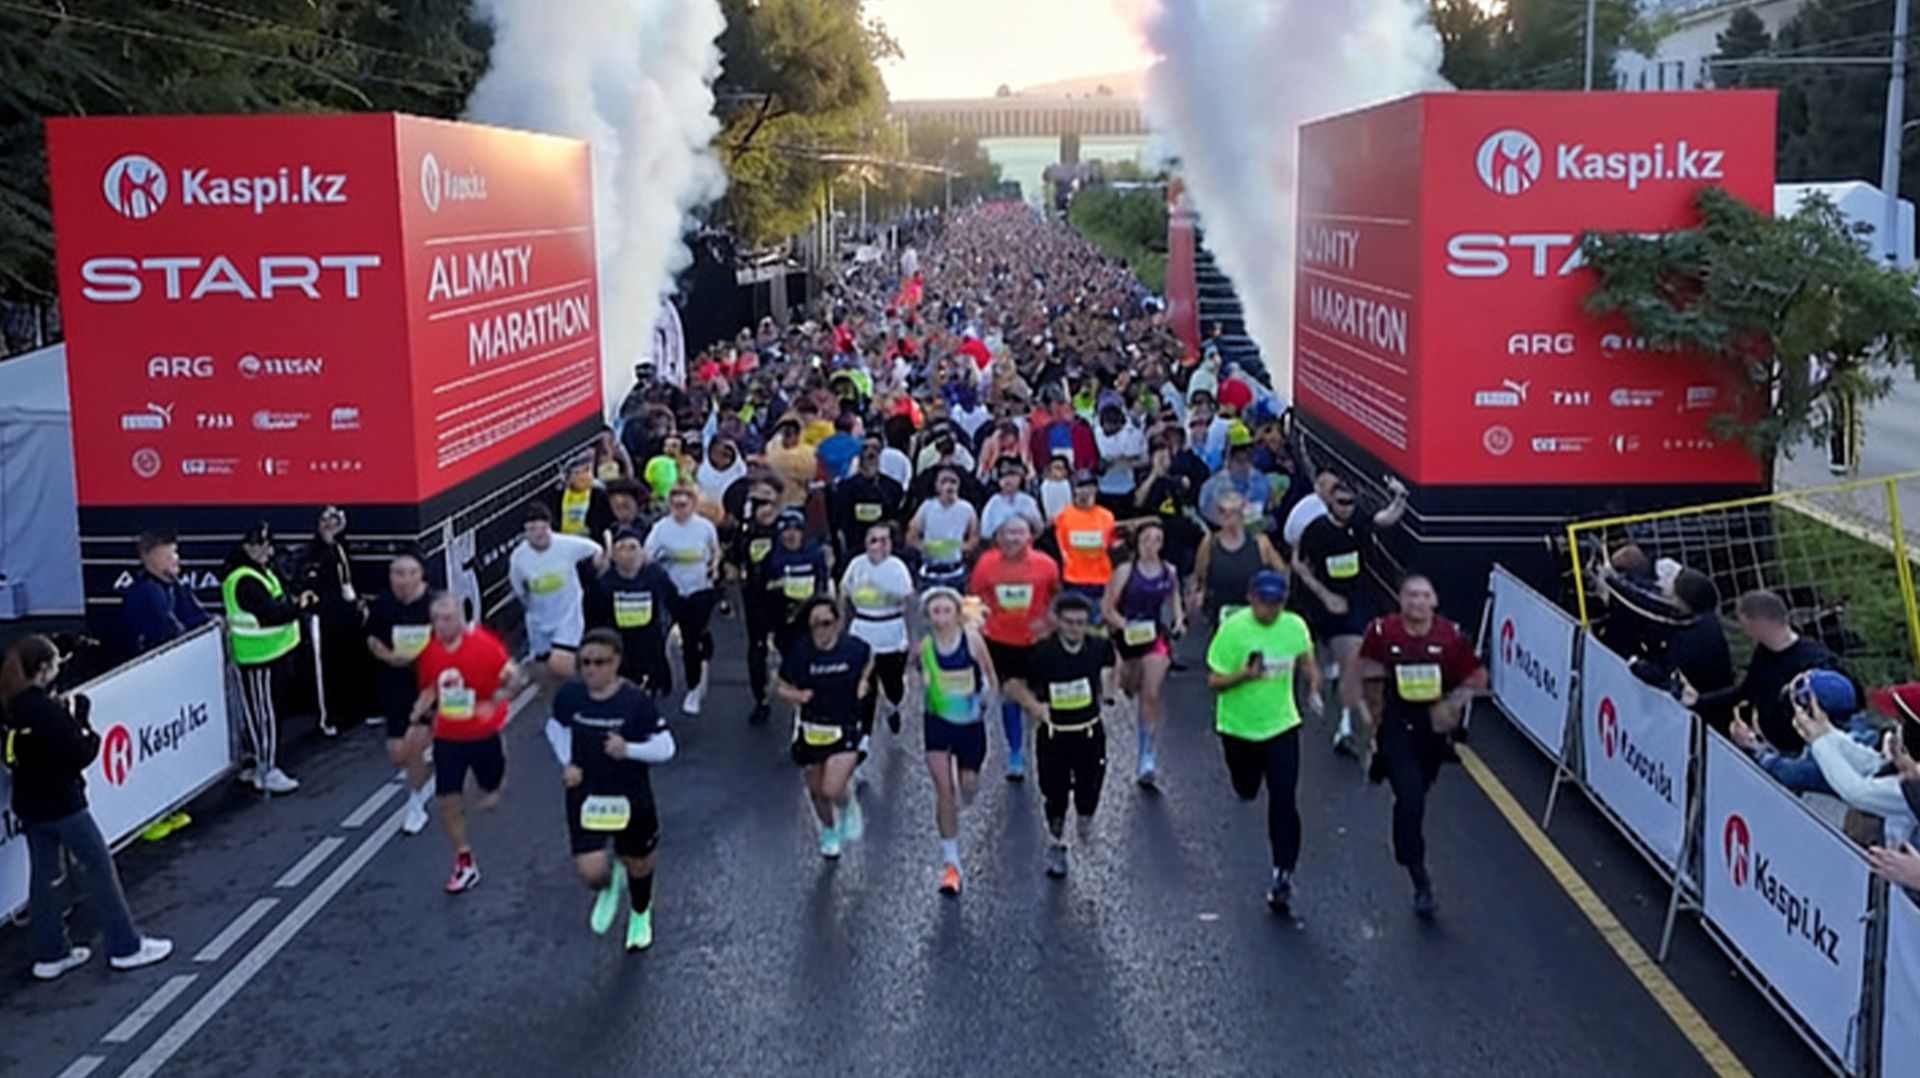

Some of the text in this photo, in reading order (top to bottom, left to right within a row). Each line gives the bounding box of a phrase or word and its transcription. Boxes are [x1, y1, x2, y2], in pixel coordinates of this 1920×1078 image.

[1556, 141, 1724, 190] Kaspi.kz
[181, 166, 347, 214] Kaspi.kz
[81, 255, 380, 301] START
[428, 245, 532, 302] ALMATY
[469, 294, 590, 367] MARATHON
[1508, 333, 1575, 355] ARG
[148, 355, 214, 378] ARG
[1753, 853, 1840, 966] Kaspi.kz
